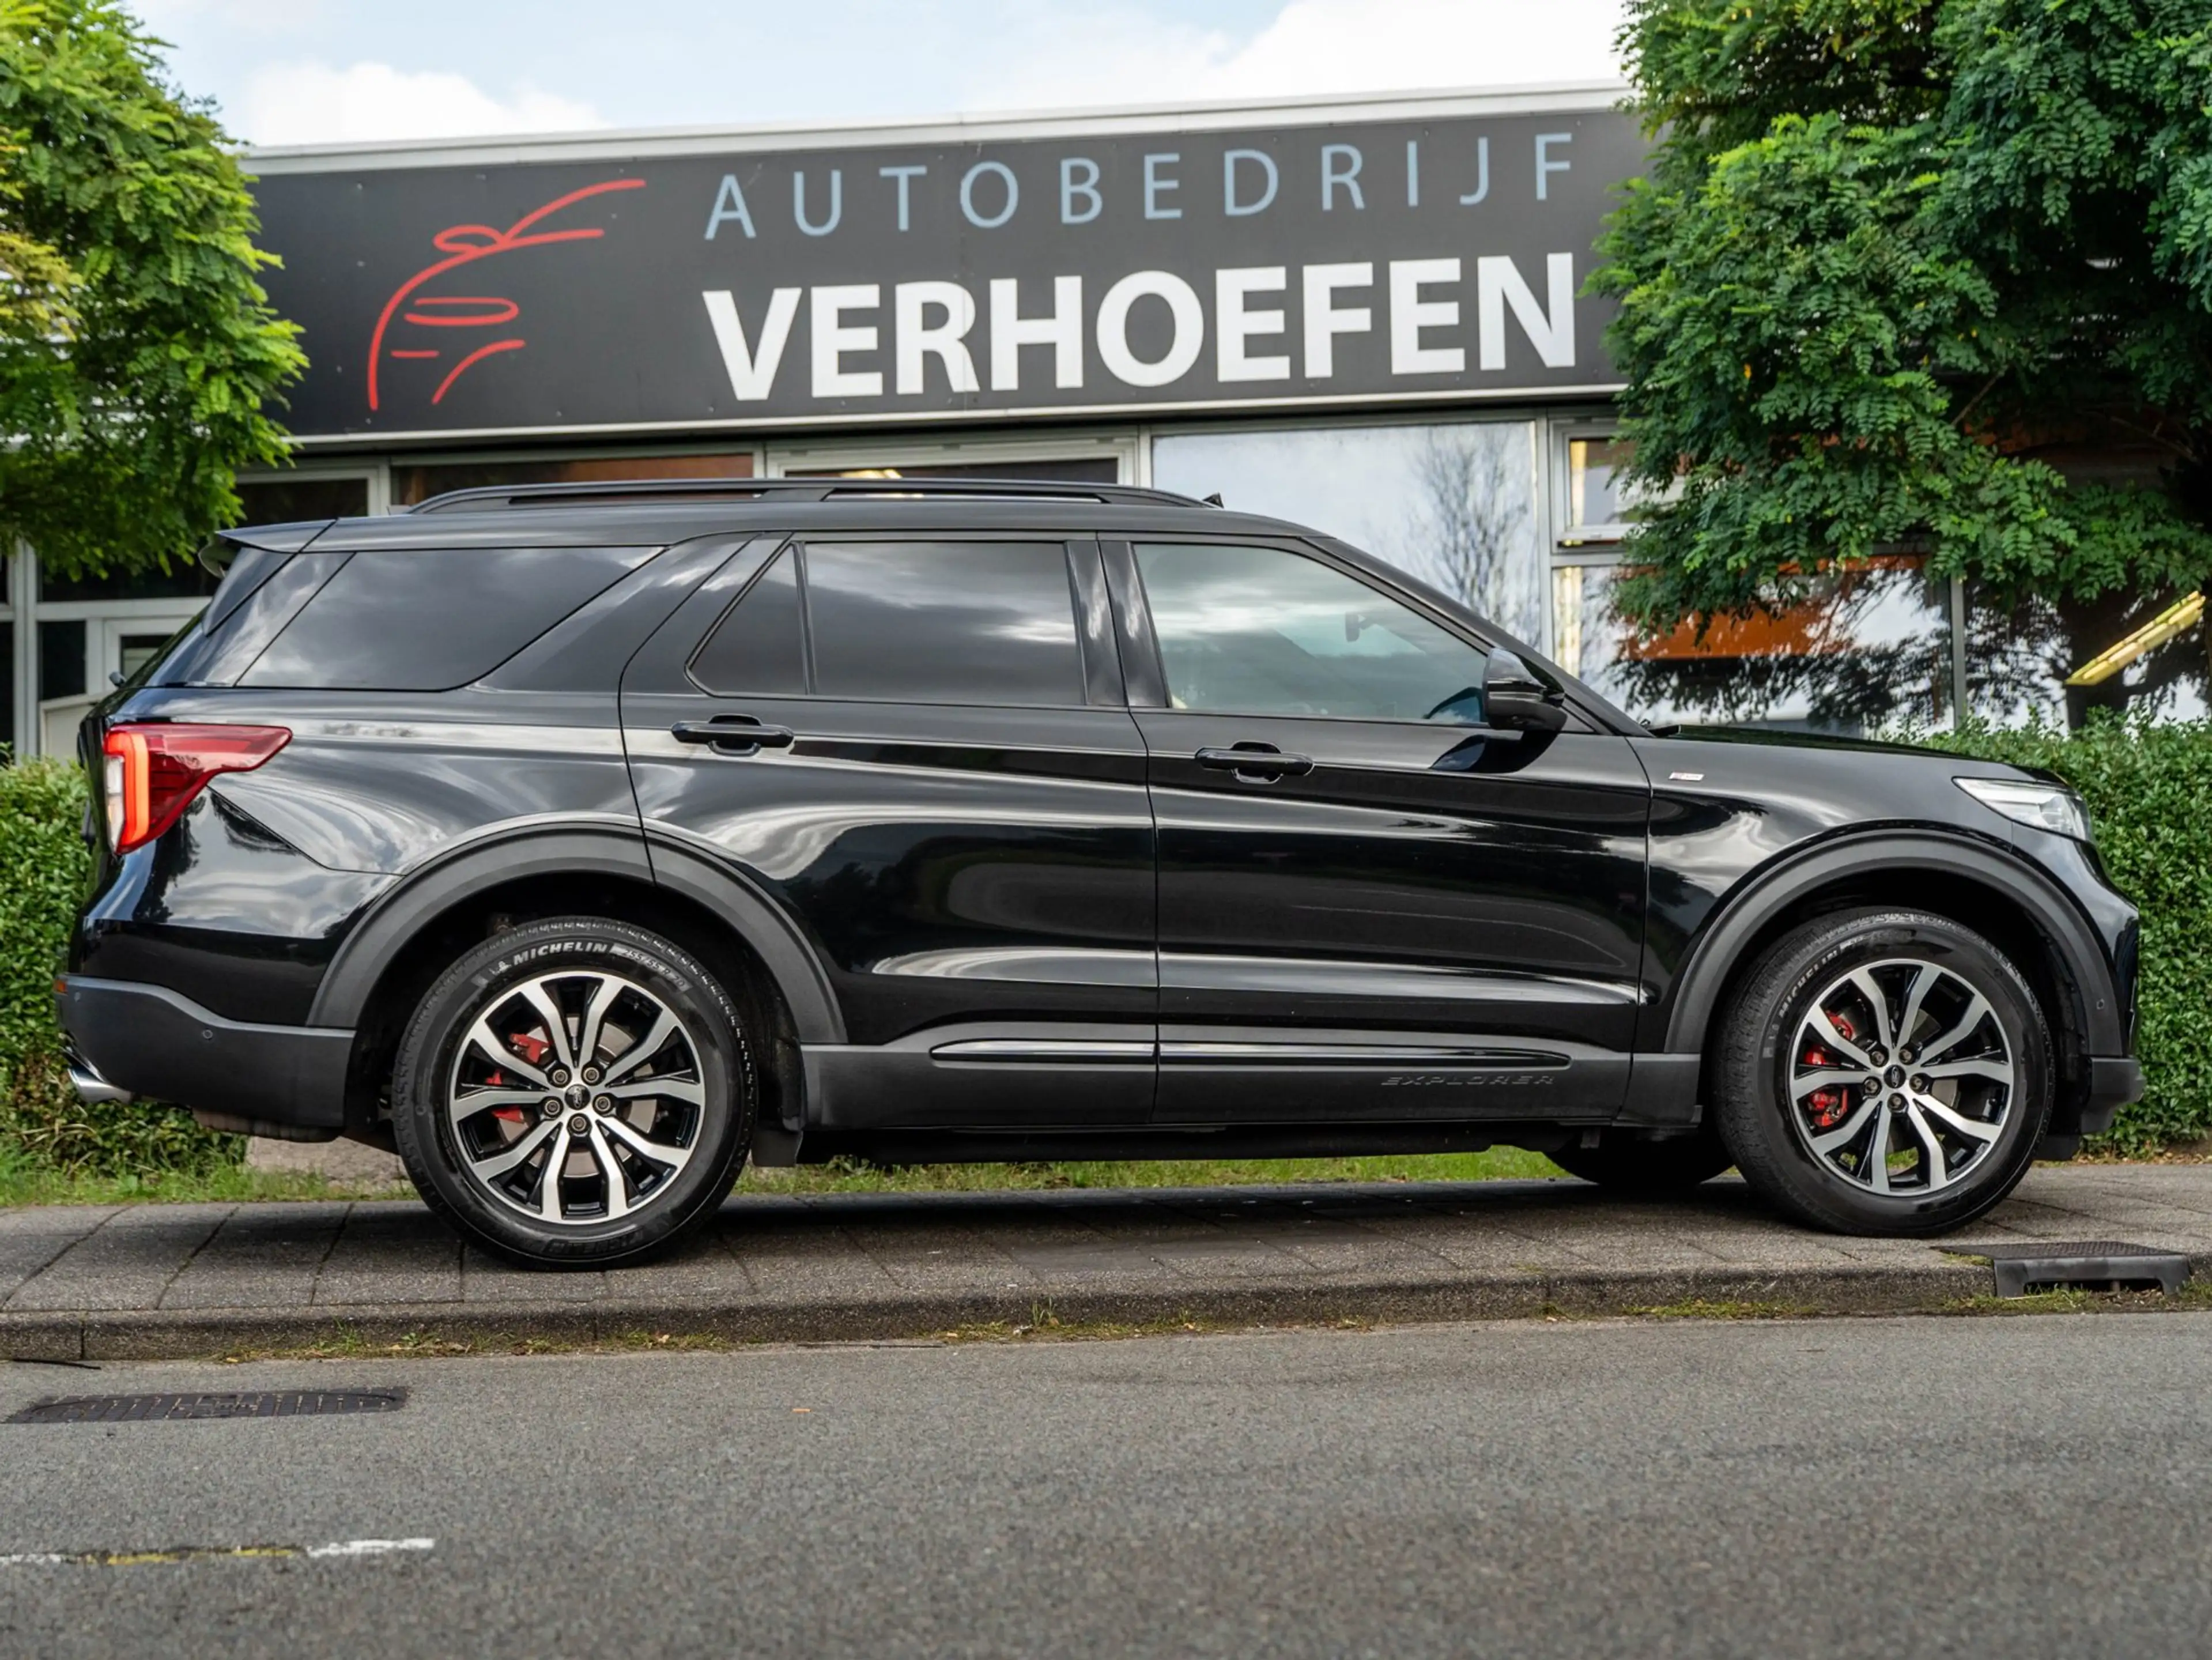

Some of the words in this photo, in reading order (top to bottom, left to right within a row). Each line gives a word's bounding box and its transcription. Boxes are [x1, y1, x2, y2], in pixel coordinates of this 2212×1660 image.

[704, 133, 1573, 241] AUTOBEDRIJF
[703, 252, 1576, 401] VERHOEFEN
[513, 941, 608, 965] MICHELIN
[1380, 1075, 1556, 1086] EXPLORER
